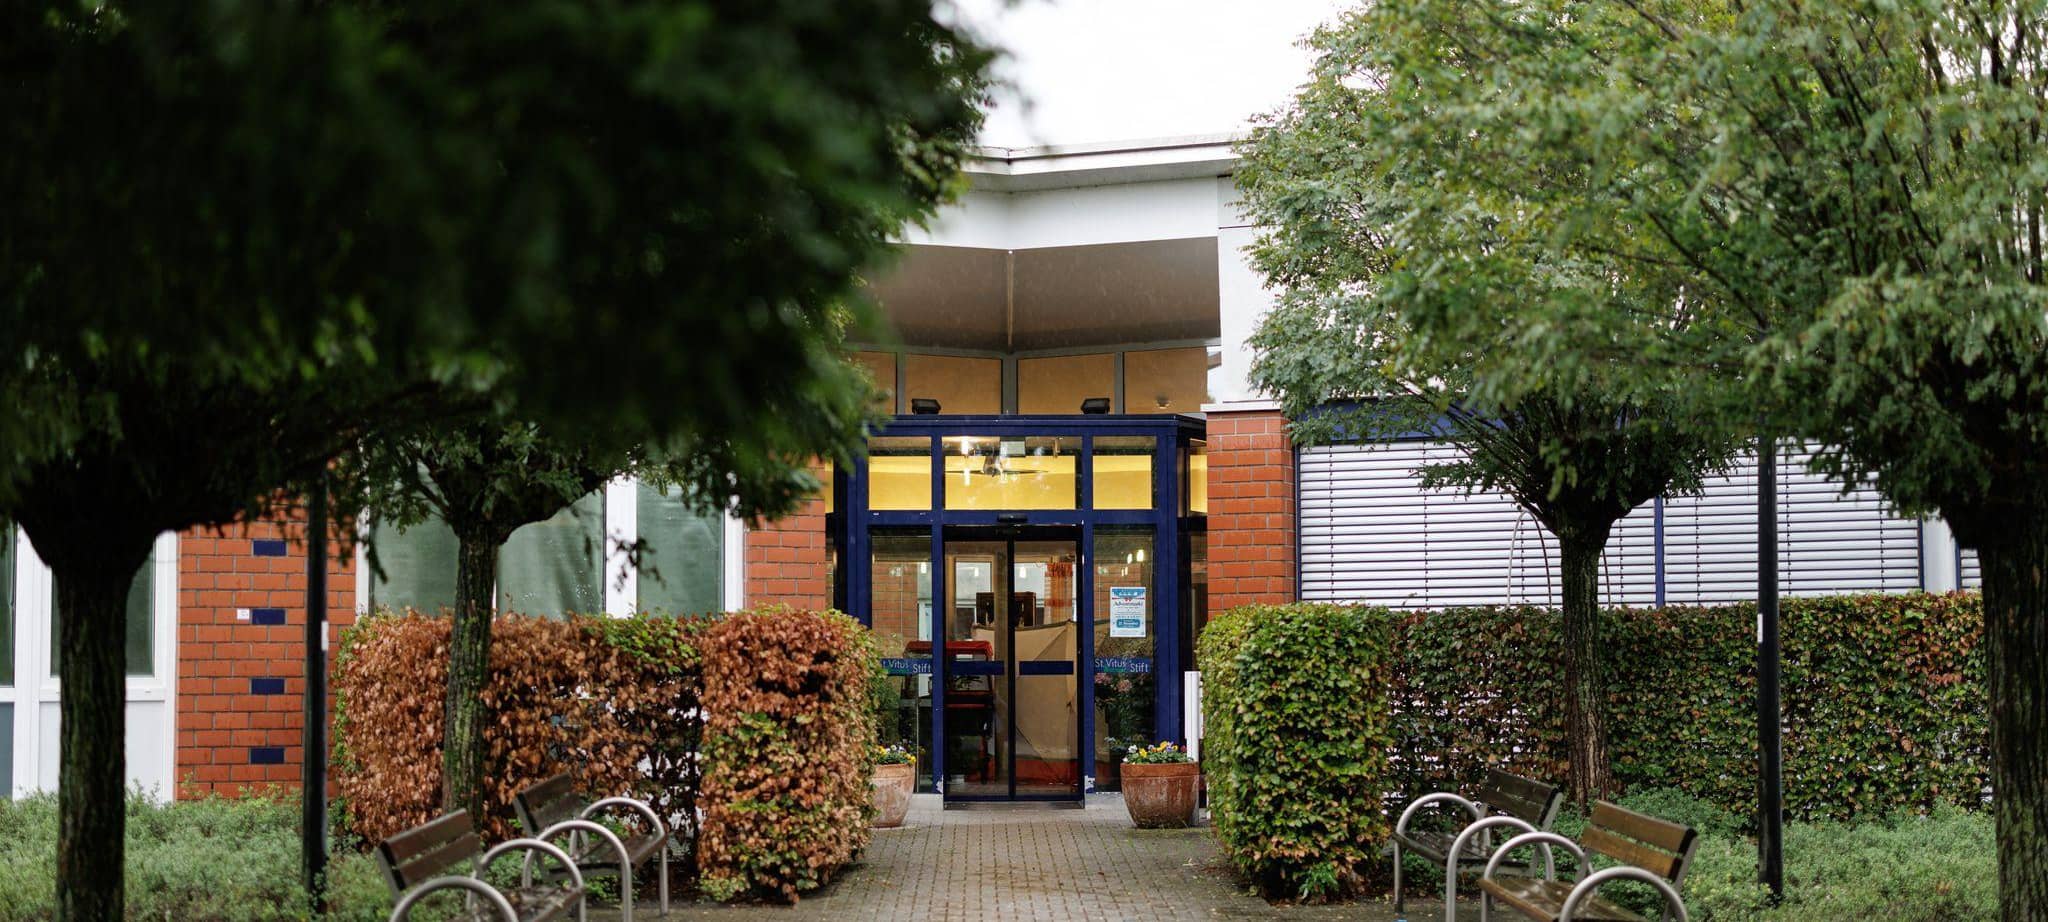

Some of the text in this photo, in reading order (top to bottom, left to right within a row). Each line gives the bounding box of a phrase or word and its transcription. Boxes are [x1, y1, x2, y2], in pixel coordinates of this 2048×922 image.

[912, 663, 931, 673] Stift
[1106, 659, 1127, 668] Vitus
[1130, 662, 1148, 673] Stift
